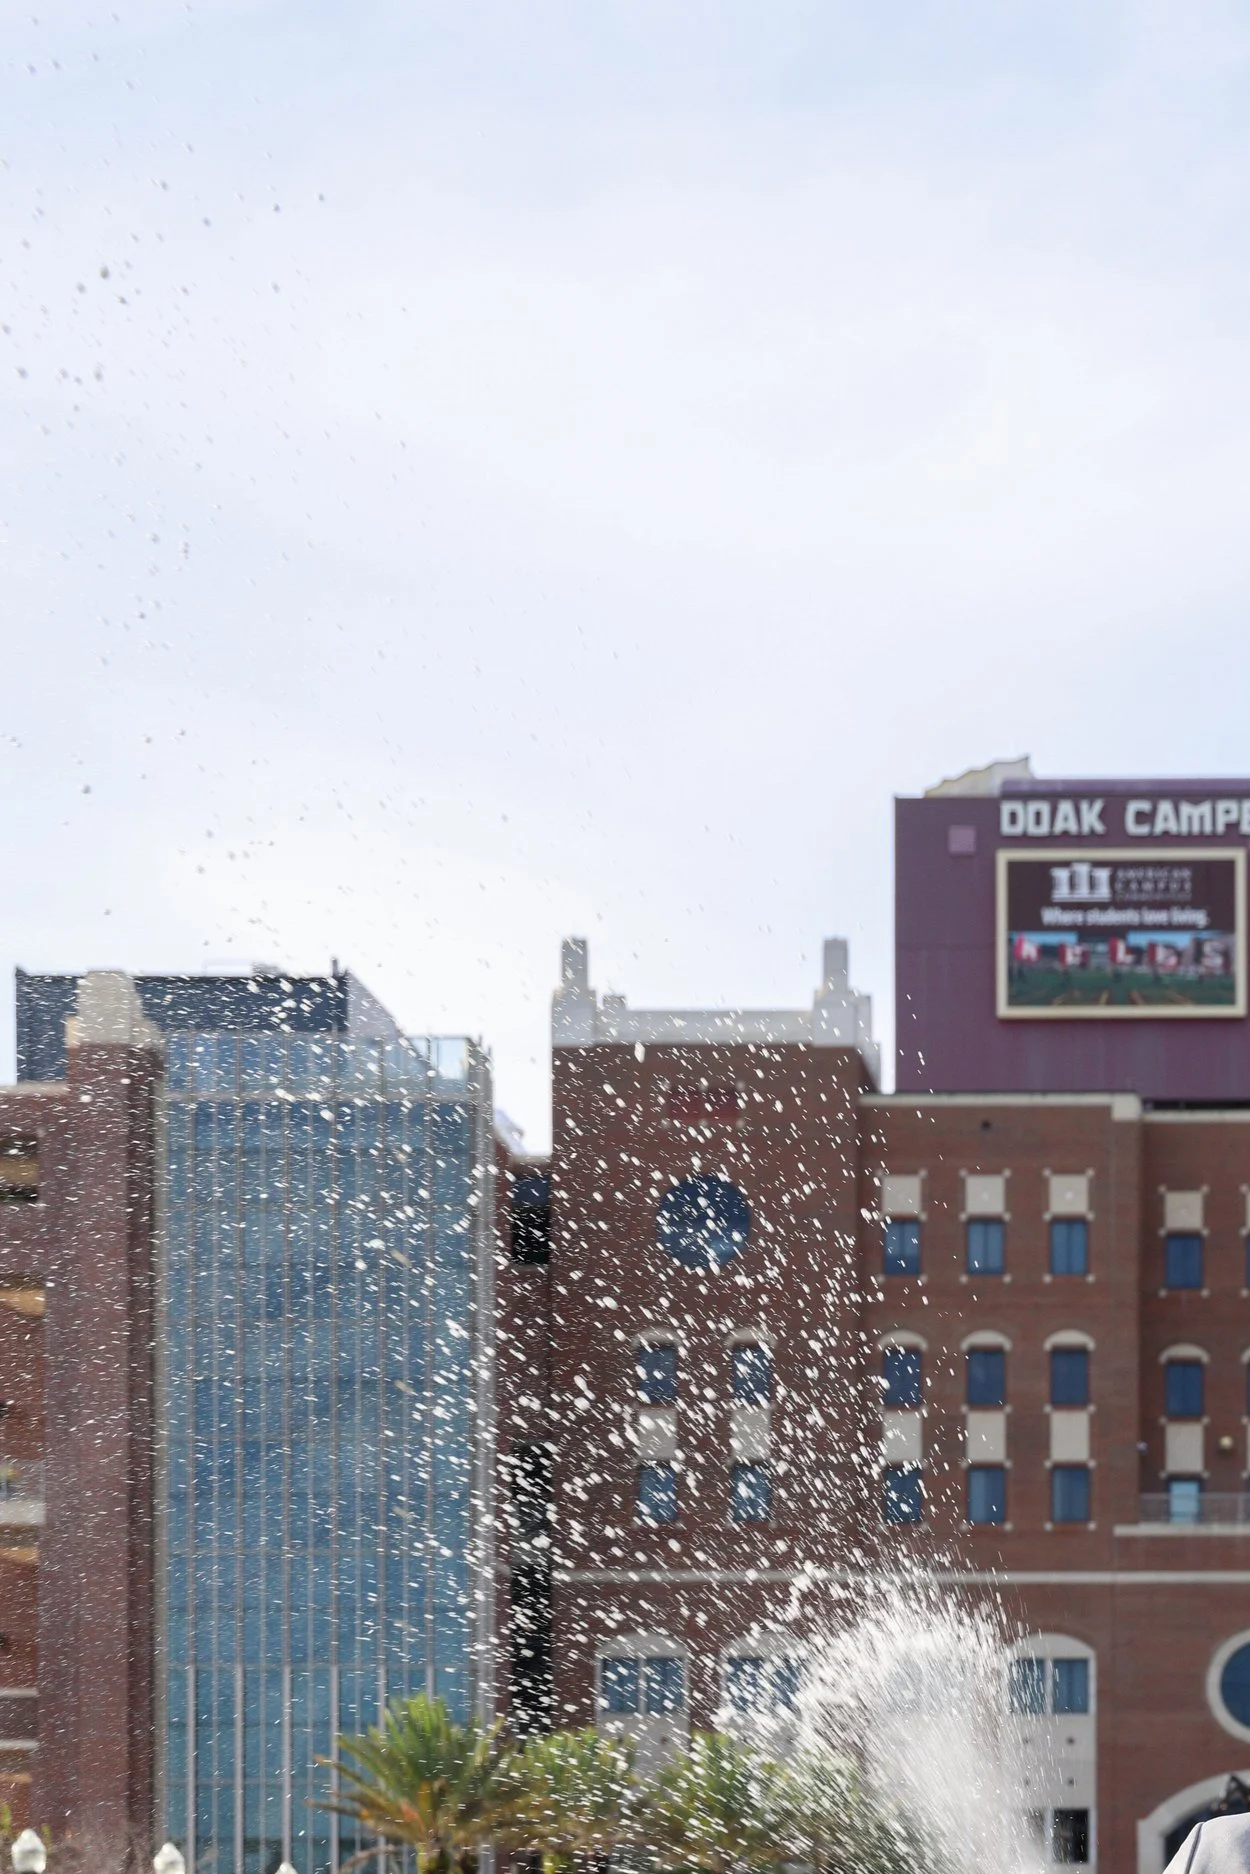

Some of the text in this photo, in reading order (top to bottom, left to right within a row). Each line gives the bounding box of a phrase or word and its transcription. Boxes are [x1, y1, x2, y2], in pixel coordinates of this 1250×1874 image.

[1001, 800, 1106, 836] DOAK
[1041, 906, 1084, 925] Where
[1086, 907, 1140, 925] students
[1141, 906, 1169, 925] love
